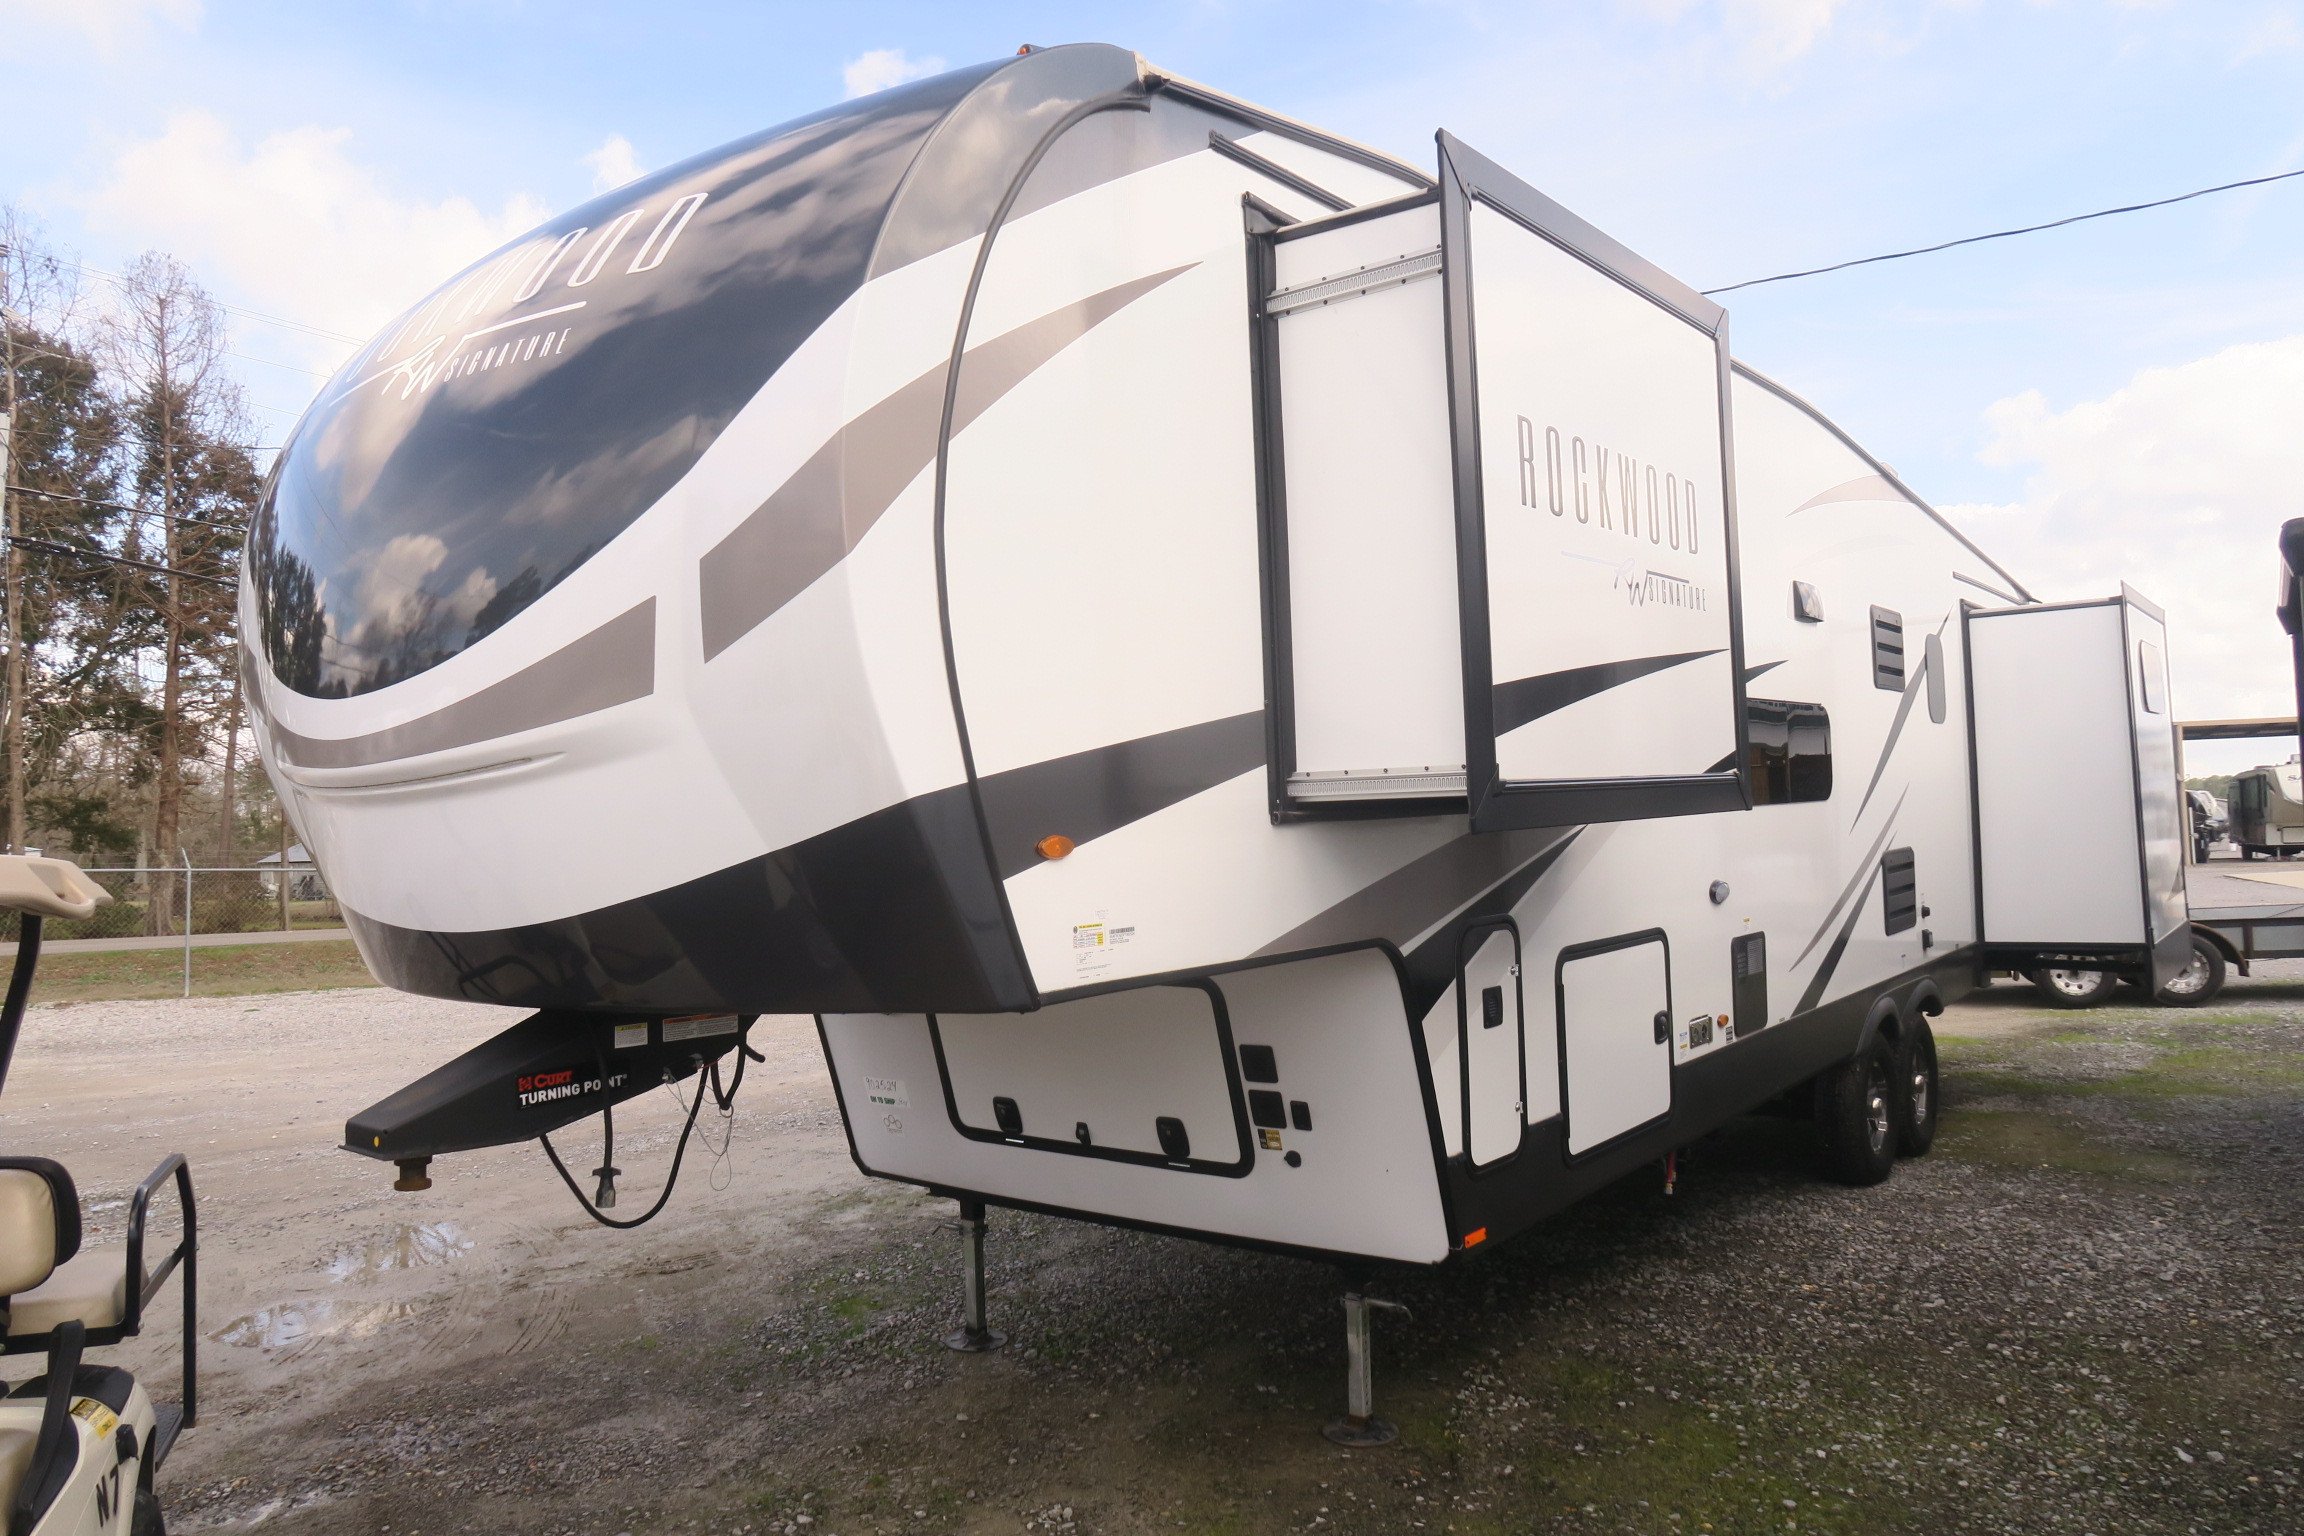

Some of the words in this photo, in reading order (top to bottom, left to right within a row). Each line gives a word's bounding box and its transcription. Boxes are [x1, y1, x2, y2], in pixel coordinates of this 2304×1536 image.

[443, 327, 572, 383] SIGNATURE
[1516, 413, 1699, 555] ROCKWOOD
[1647, 576, 1707, 612] SIGNATURE
[519, 1083, 581, 1106] TURNING
[583, 1074, 623, 1093] PONT
